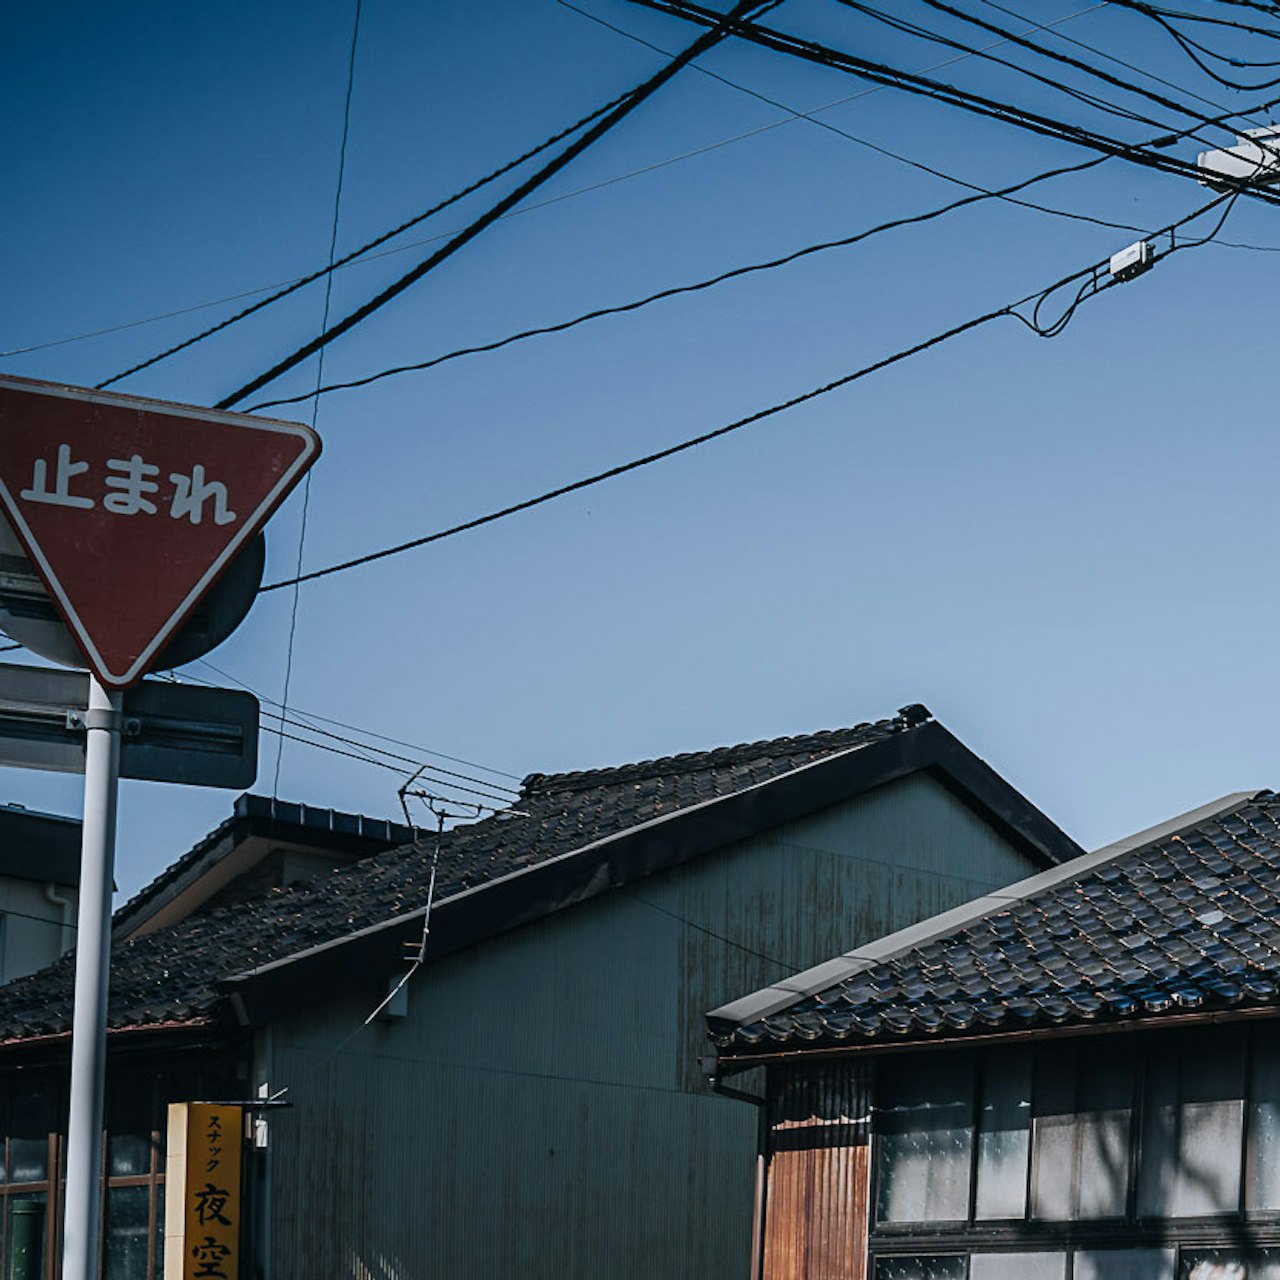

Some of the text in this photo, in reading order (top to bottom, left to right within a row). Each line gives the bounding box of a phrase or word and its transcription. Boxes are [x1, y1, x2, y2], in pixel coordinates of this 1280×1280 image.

[20, 444, 237, 526] 止まれ
[192, 1116, 232, 1279] スナック 夜空
